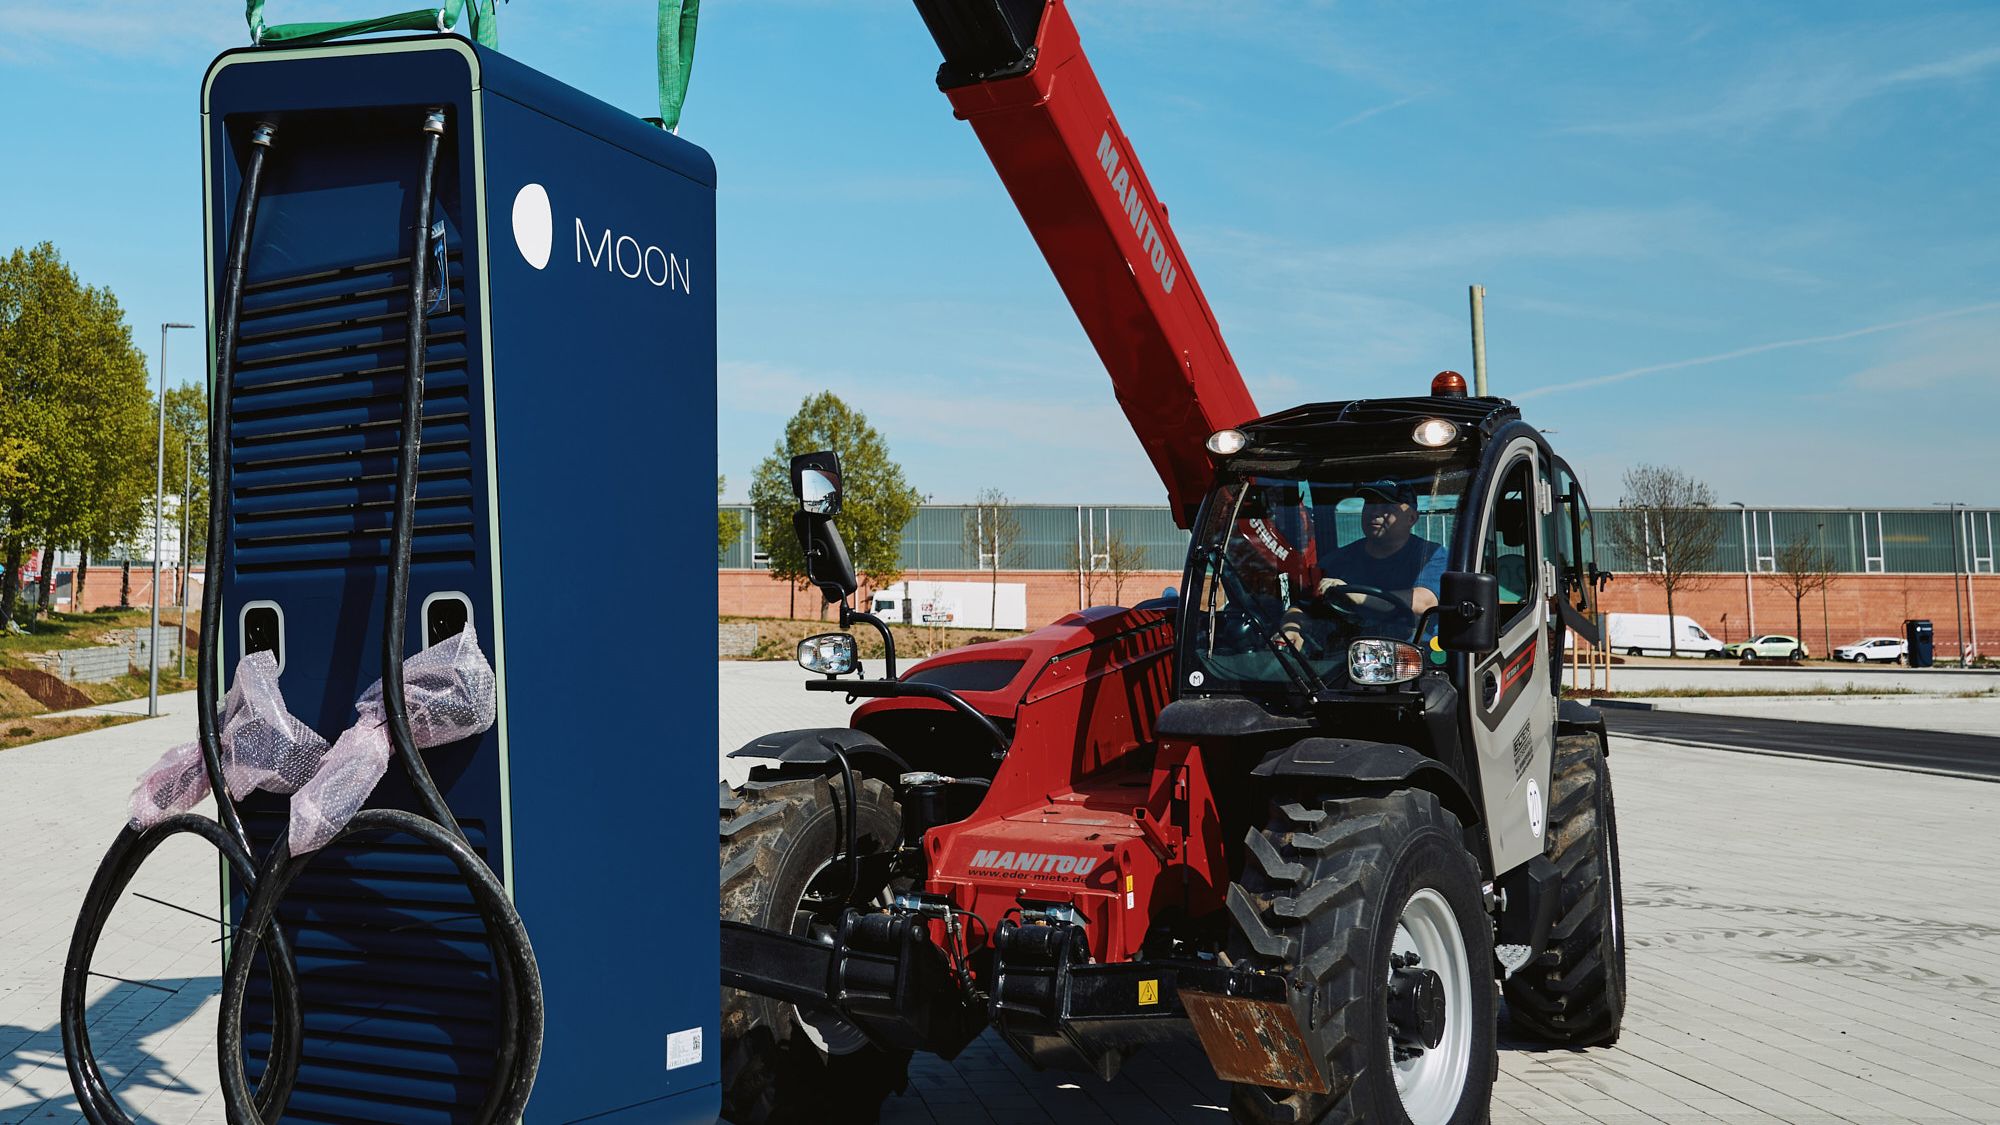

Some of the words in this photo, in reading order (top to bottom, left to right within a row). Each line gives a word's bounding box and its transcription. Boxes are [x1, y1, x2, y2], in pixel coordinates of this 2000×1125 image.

[1096, 129, 1177, 294] MANITOU
[575, 217, 690, 295] MOON
[969, 849, 1098, 875] MANITOU
